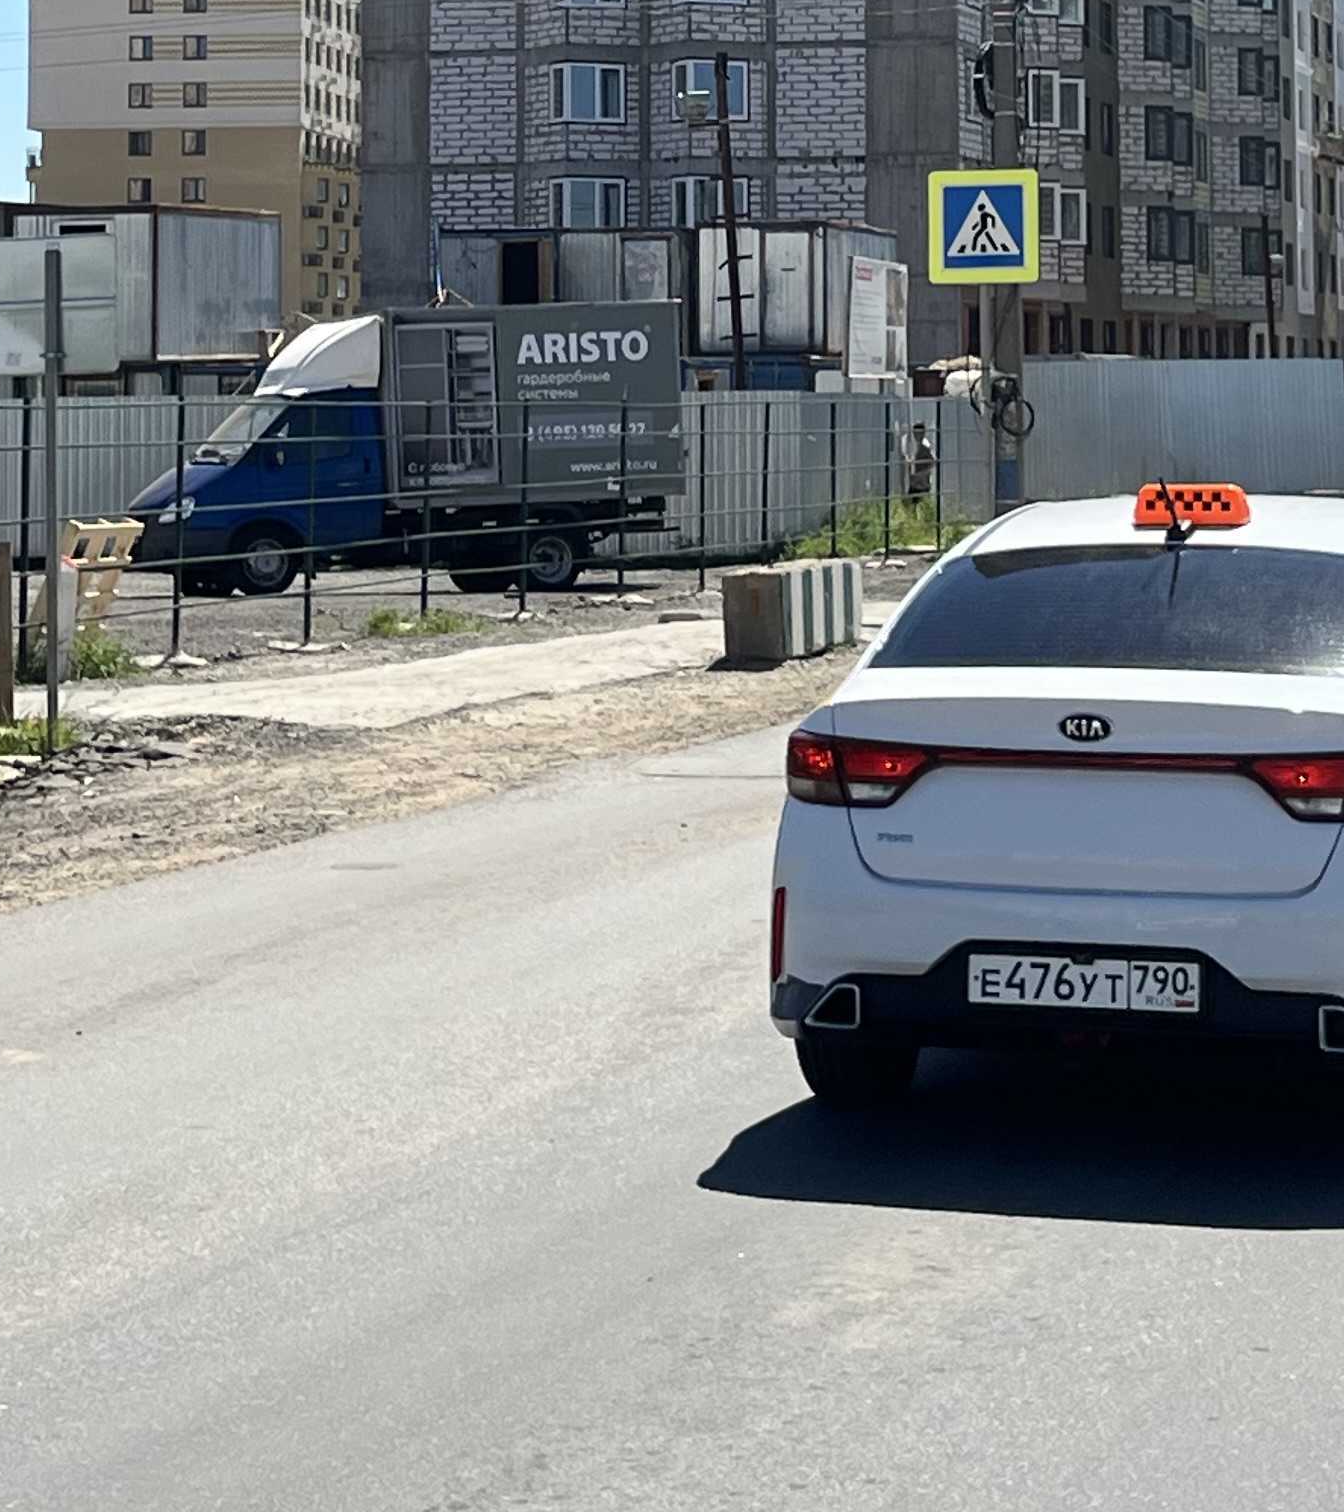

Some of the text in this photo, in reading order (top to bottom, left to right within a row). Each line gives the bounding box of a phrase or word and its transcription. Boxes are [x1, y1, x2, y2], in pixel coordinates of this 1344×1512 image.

[517, 330, 649, 365] ARISTO
[517, 369, 611, 386] гардеробные
[517, 389, 578, 401] системы
[570, 458, 657, 473] www.arito.ru
[1065, 719, 1105, 737] KIA
[981, 961, 1190, 1004] Е476УТ 790
